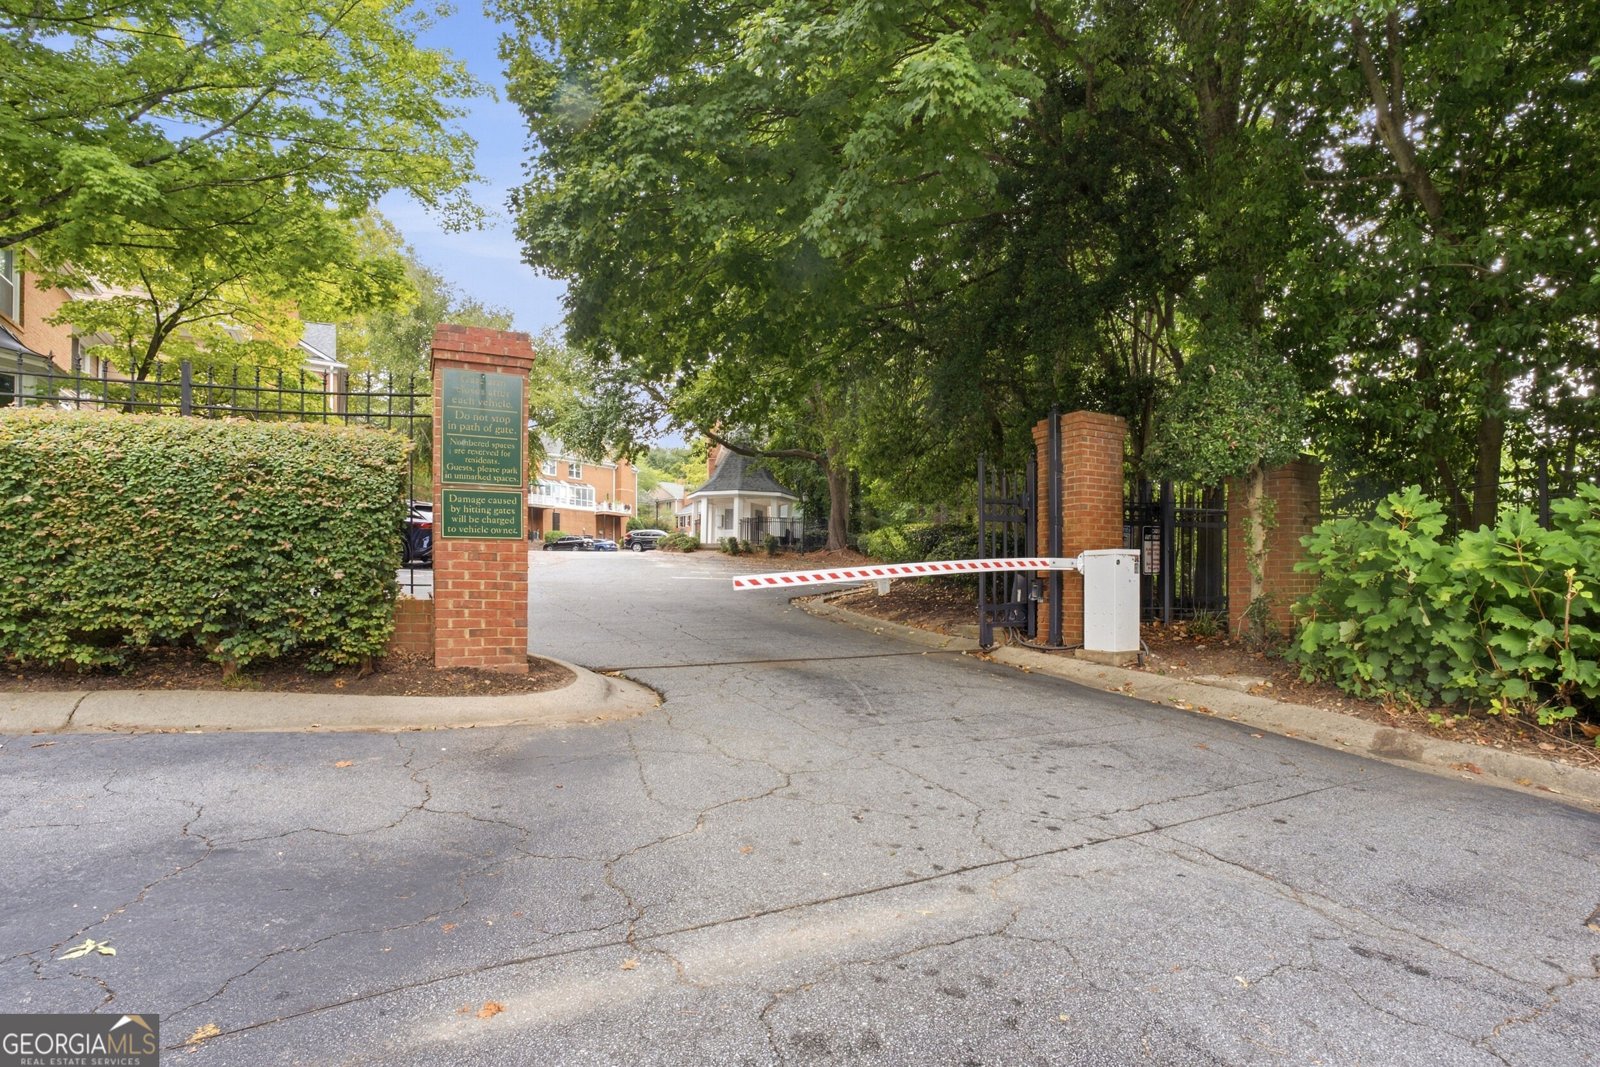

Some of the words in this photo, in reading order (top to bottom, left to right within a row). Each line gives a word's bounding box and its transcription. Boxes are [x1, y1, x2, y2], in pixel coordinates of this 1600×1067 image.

[452, 398, 475, 406] each
[479, 399, 513, 409] vehicle.
[455, 410, 470, 419] Do
[473, 414, 488, 422] not
[491, 416, 511, 425] stop
[447, 420, 457, 430] in
[460, 423, 480, 432] path
[483, 423, 492, 432] of
[495, 426, 517, 435] gate.
[467, 449, 499, 457] reserved
[465, 456, 500, 464] residents.
[446, 463, 475, 472] Guests,
[477, 465, 500, 474] please
[501, 466, 518, 475] park
[445, 471, 453, 479] in
[454, 472, 492, 481] unmarked
[449, 494, 486, 505] Damage
[487, 497, 517, 505] caused
[450, 505, 461, 514] by
[463, 505, 492, 515] hitting
[493, 507, 516, 516] gates
[451, 515, 466, 523] will
[481, 516, 515, 525] charged
[459, 525, 489, 534] vehicle
